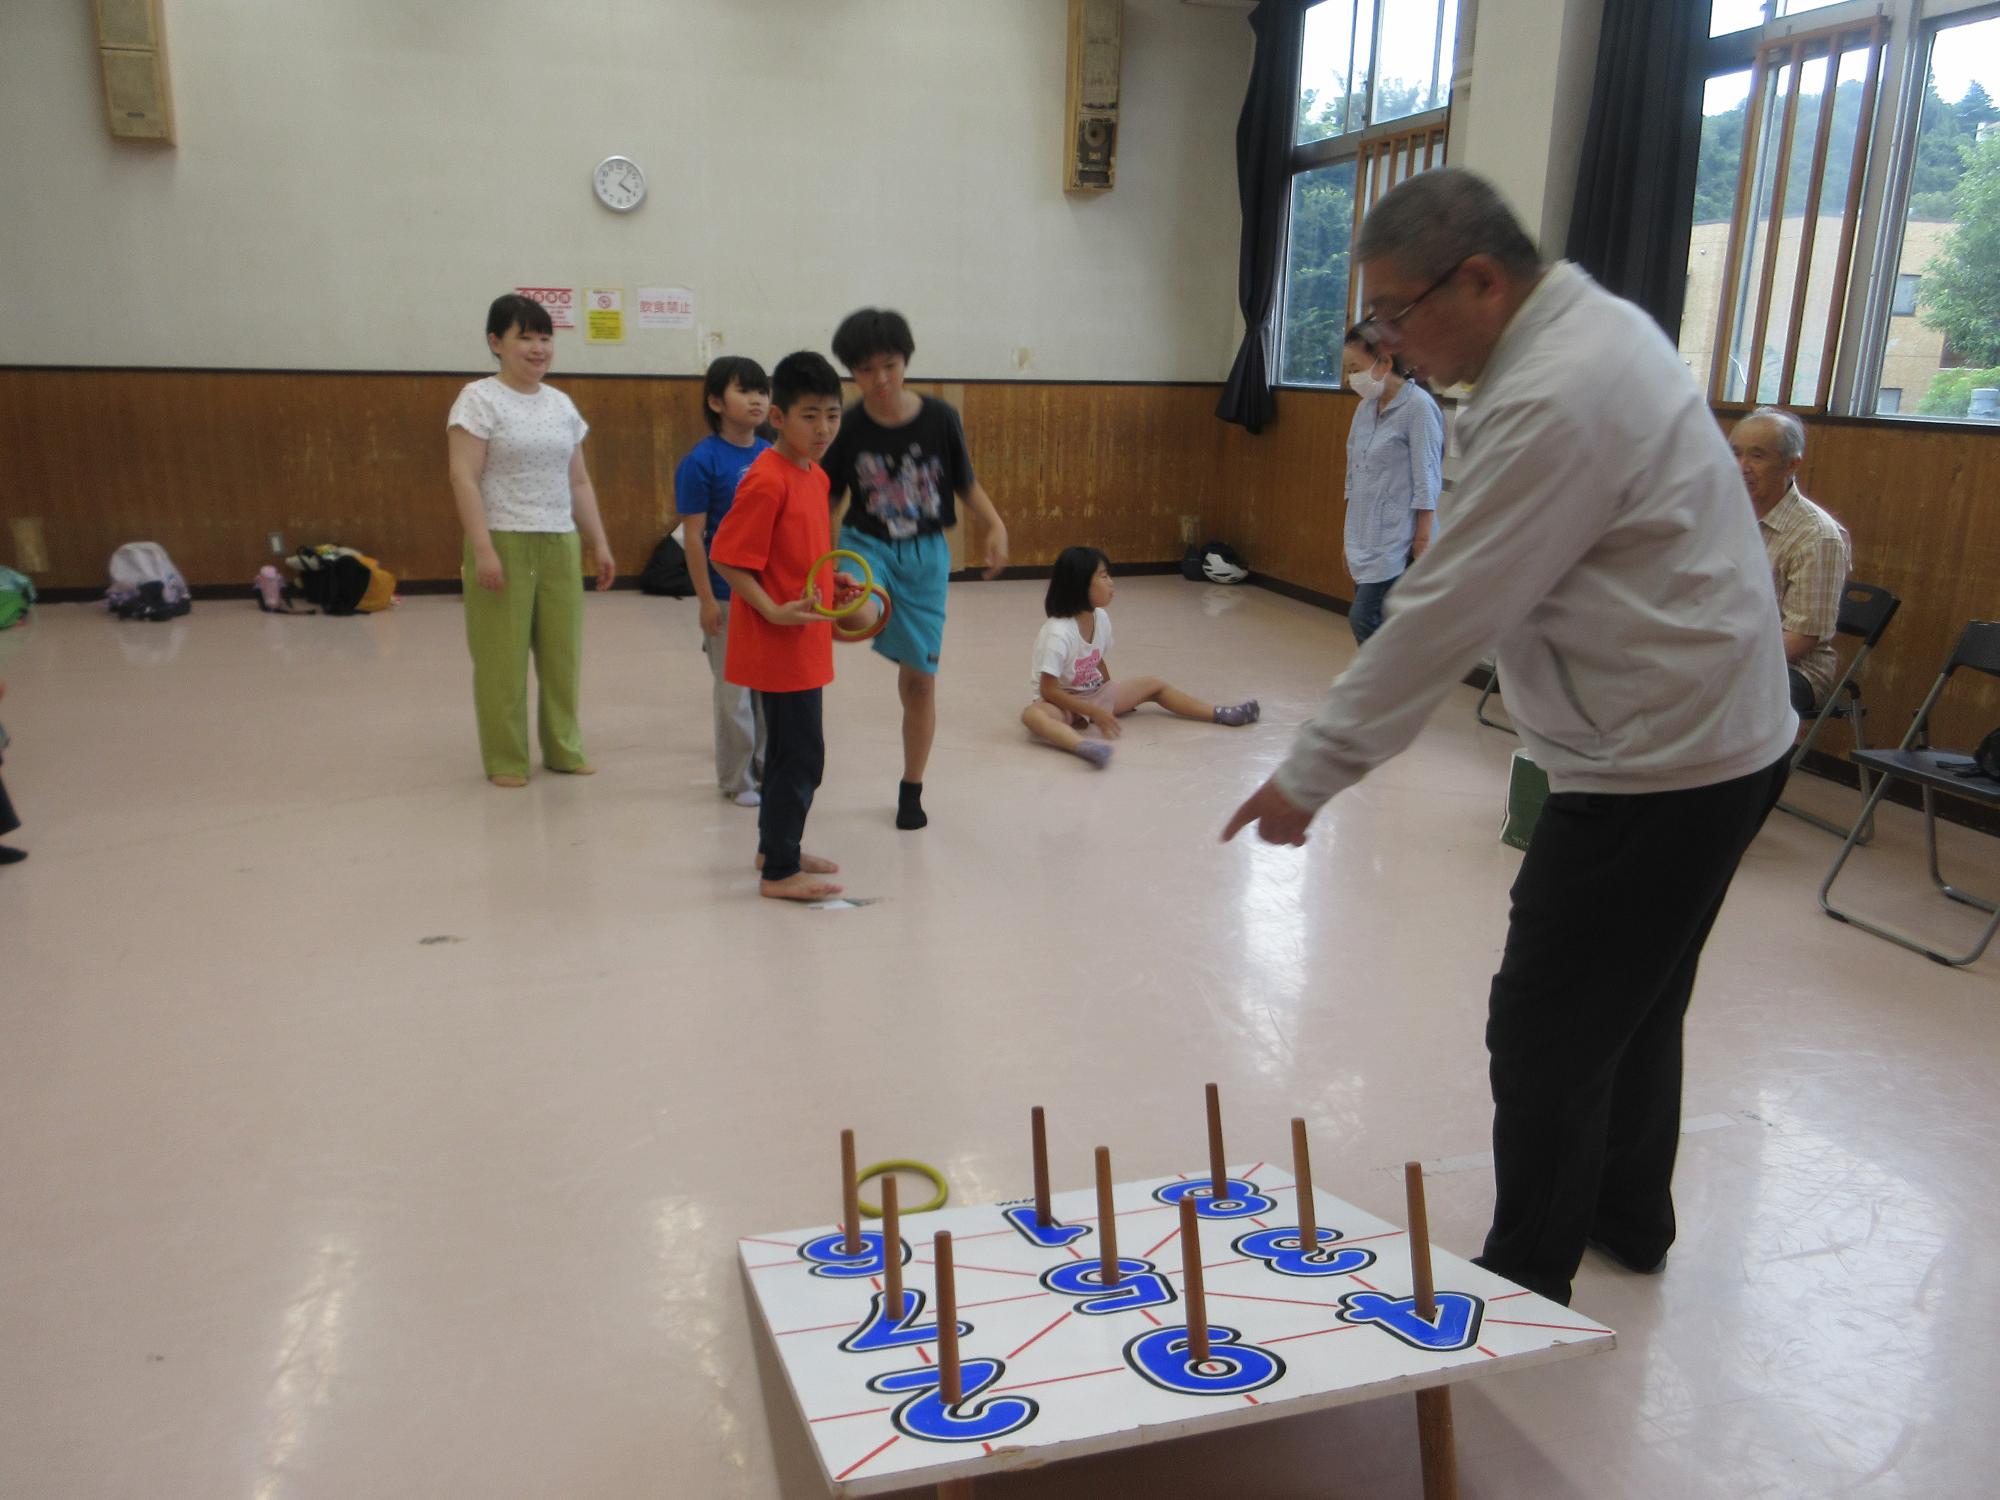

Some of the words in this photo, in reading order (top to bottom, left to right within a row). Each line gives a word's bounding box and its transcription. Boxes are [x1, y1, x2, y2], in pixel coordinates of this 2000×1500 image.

[1001, 1206, 1093, 1248] 1
[1152, 1178, 1278, 1220] 8
[1230, 1226, 1377, 1277] 3
[1039, 1257, 1178, 1315] 5
[837, 1288, 974, 1353] 7
[1335, 1291, 1485, 1352] 4
[865, 1357, 1040, 1444] 2
